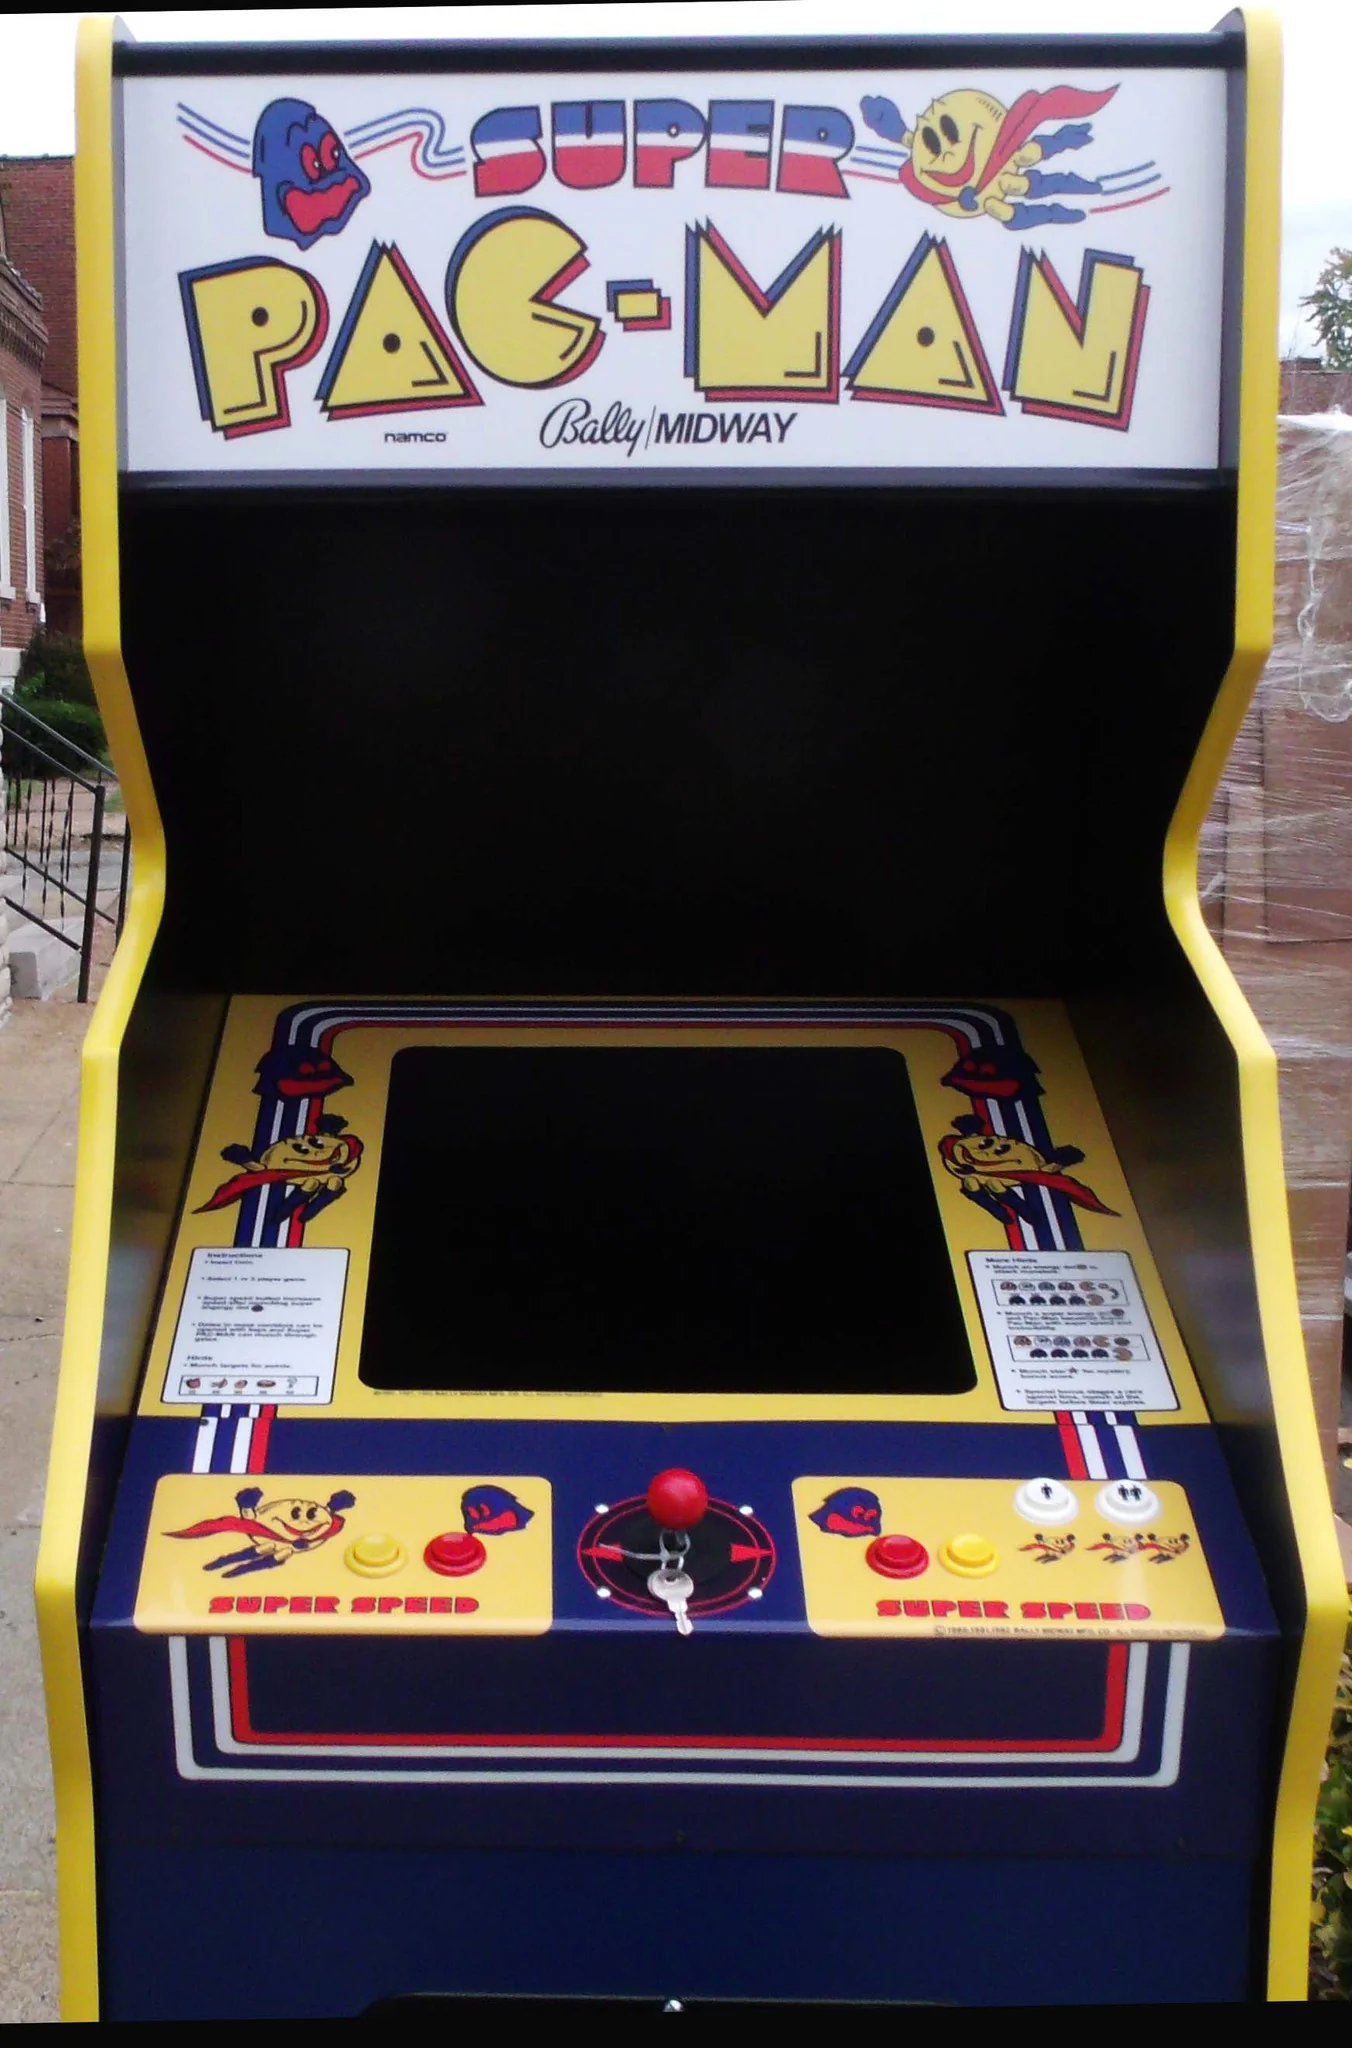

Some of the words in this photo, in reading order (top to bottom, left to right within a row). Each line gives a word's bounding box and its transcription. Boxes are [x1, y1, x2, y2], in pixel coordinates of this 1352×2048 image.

[470, 99, 856, 199] SUPER
[177, 204, 1150, 441] PAC-MAN
[383, 432, 447, 444] namco
[208, 1596, 341, 1614] SUPER
[350, 1596, 479, 1614] SPEED
[876, 1599, 1010, 1619] SUPER
[1020, 1601, 1151, 1621] SPEED
